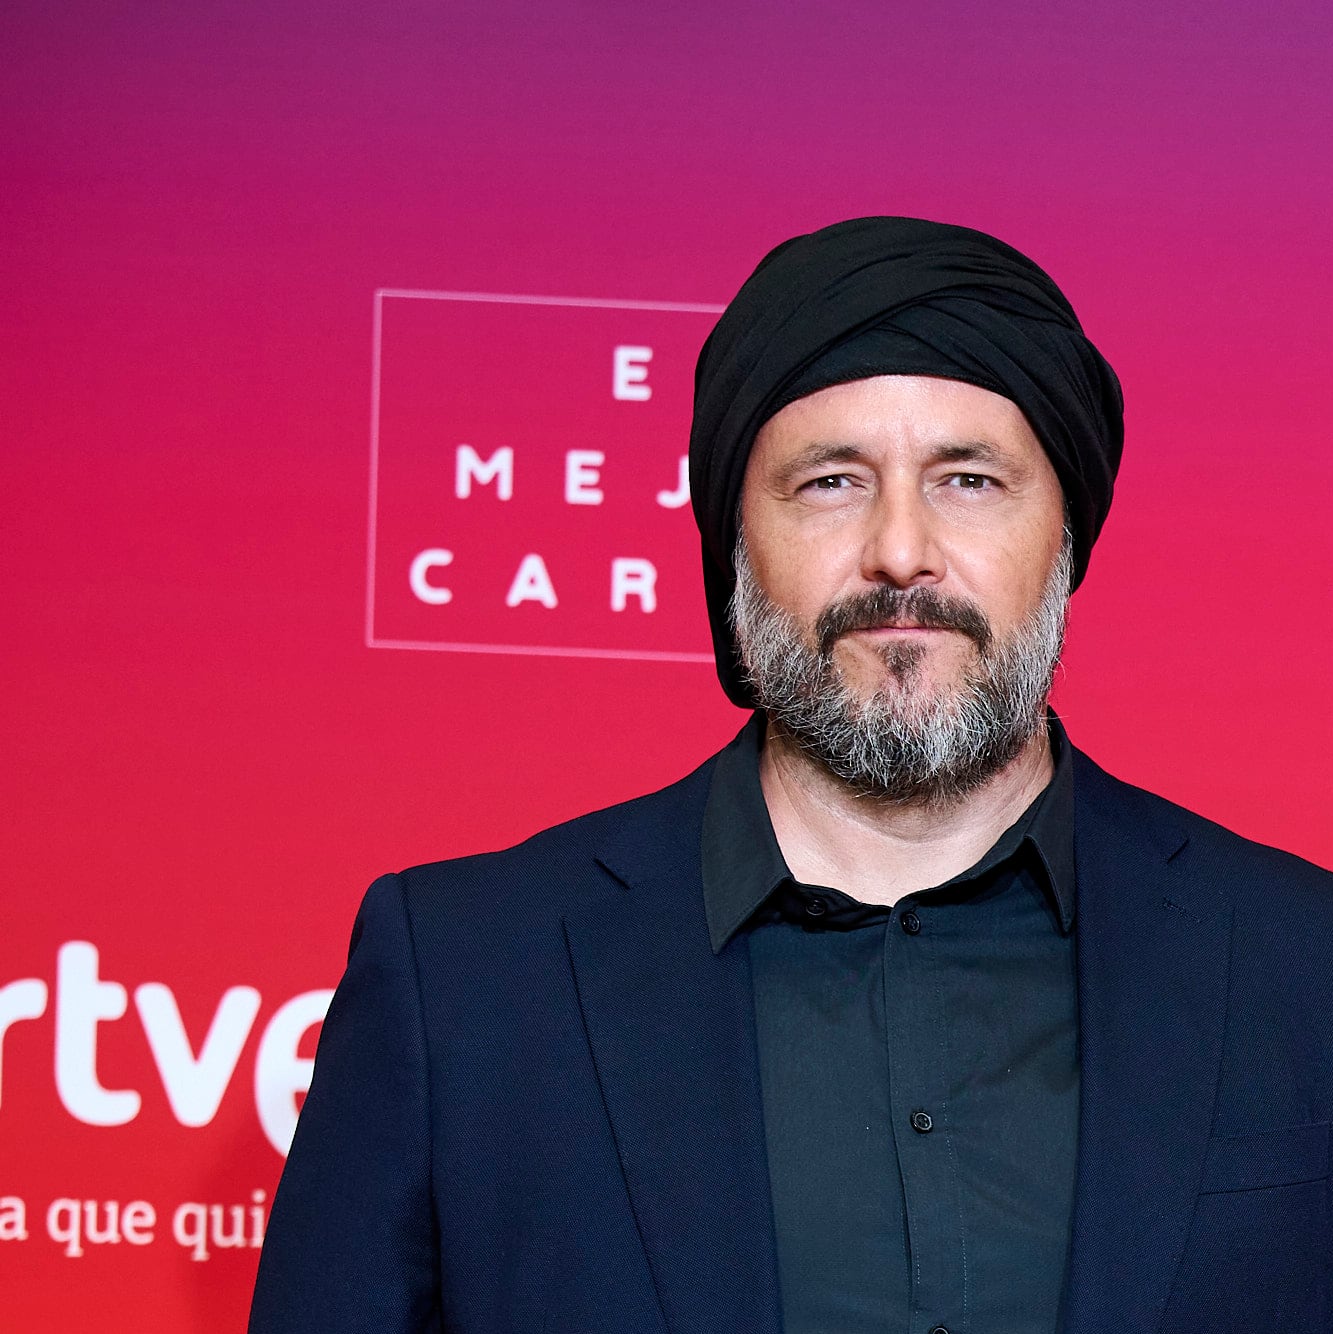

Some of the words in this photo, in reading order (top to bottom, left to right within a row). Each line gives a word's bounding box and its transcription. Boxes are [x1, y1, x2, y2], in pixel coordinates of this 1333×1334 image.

[612, 345, 654, 402] E
[455, 444, 691, 509] MEJ
[409, 548, 658, 614] CAR
[0, 1195, 29, 1242] a
[46, 1197, 157, 1259] que
[171, 1188, 267, 1262] qui
